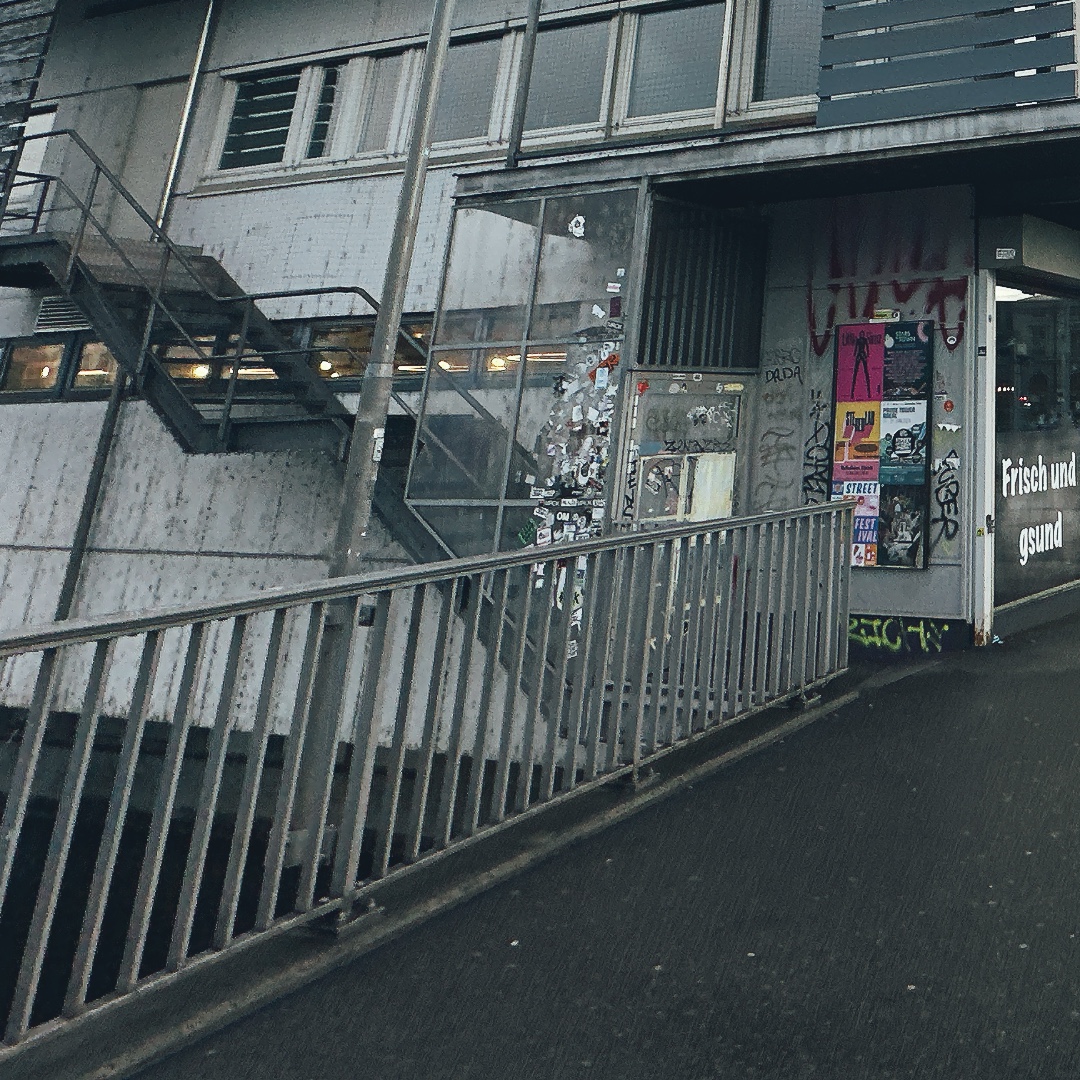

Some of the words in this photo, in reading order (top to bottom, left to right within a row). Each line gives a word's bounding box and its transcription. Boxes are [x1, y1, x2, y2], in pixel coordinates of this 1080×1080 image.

[845, 482, 878, 495] STREET
[1002, 455, 1048, 498] Frisch
[1051, 452, 1077, 489] und
[854, 518, 876, 530] FEST
[1019, 511, 1063, 566] gsund
